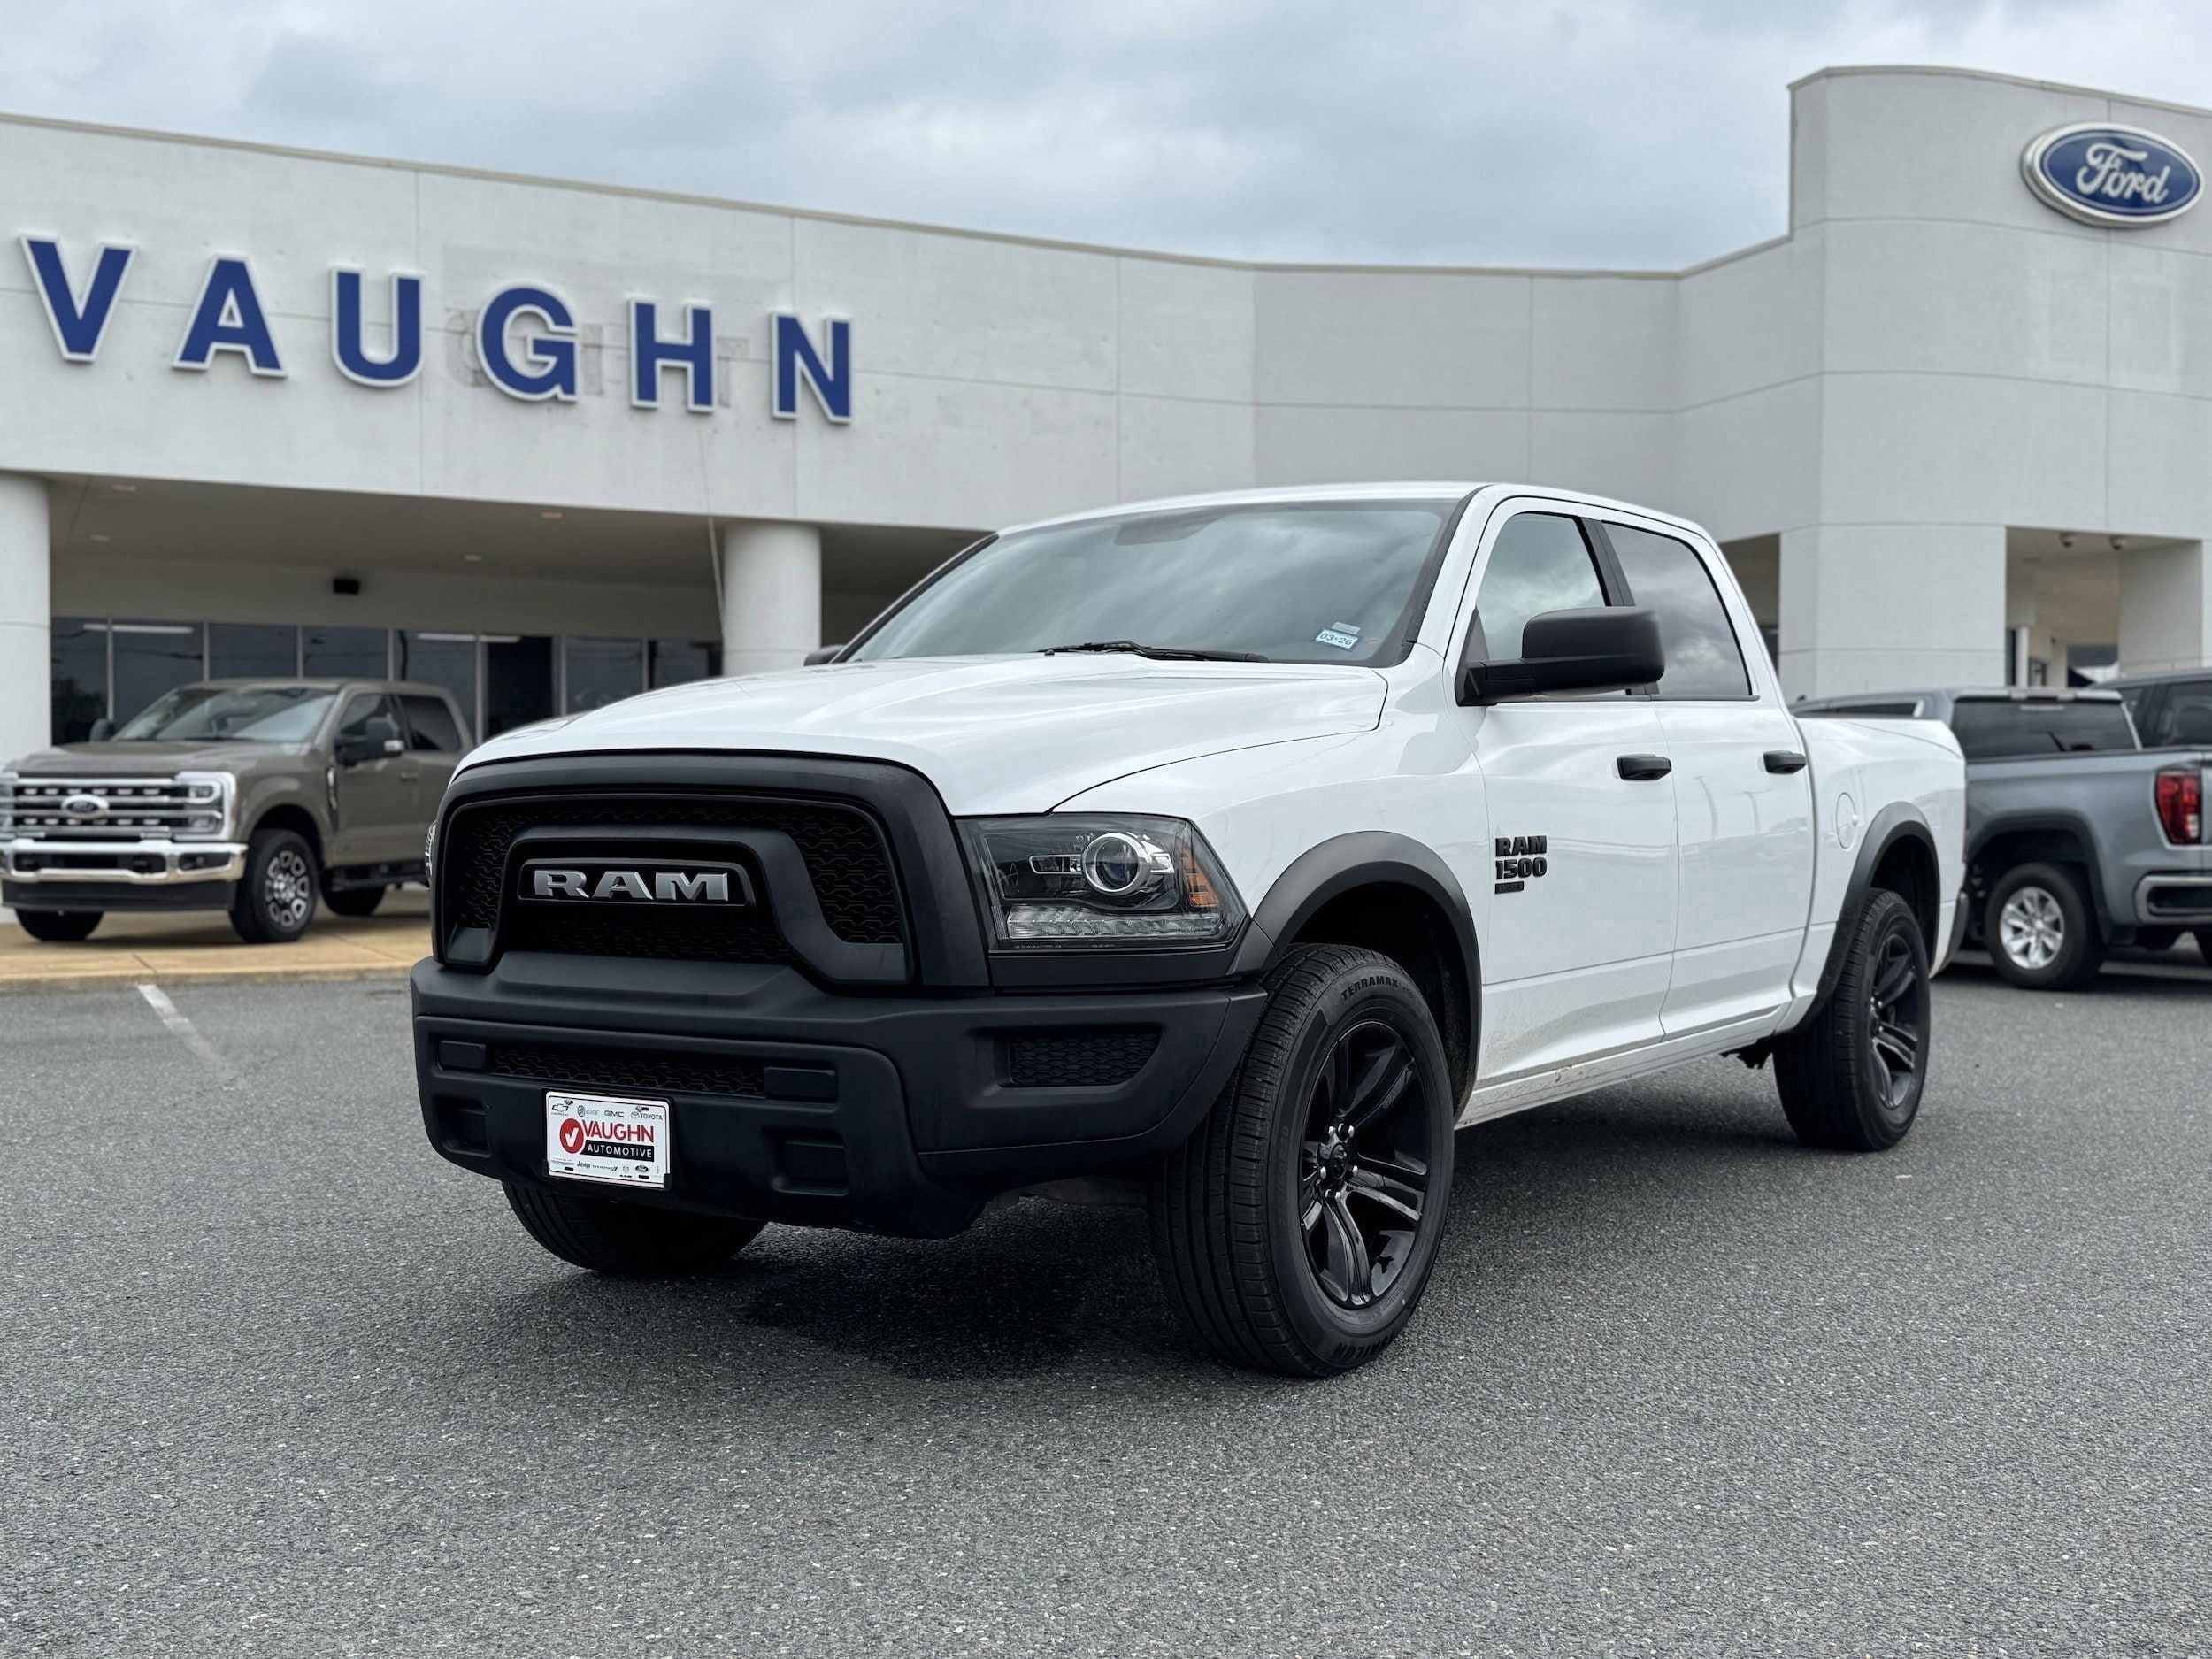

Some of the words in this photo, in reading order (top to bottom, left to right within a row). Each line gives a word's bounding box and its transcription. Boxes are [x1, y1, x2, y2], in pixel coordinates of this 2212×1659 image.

[2075, 142, 2171, 204] Ford
[19, 233, 855, 426] VAUGHN
[1494, 835, 1548, 857] RAM
[1495, 857, 1548, 879] 1500
[534, 869, 729, 902] RAM
[1340, 975, 1398, 1002] TERRAMAX
[582, 1119, 654, 1143] VAUGHN
[587, 1143, 652, 1158] AUTOMOTIVE
[576, 1160, 591, 1169] Jeep
